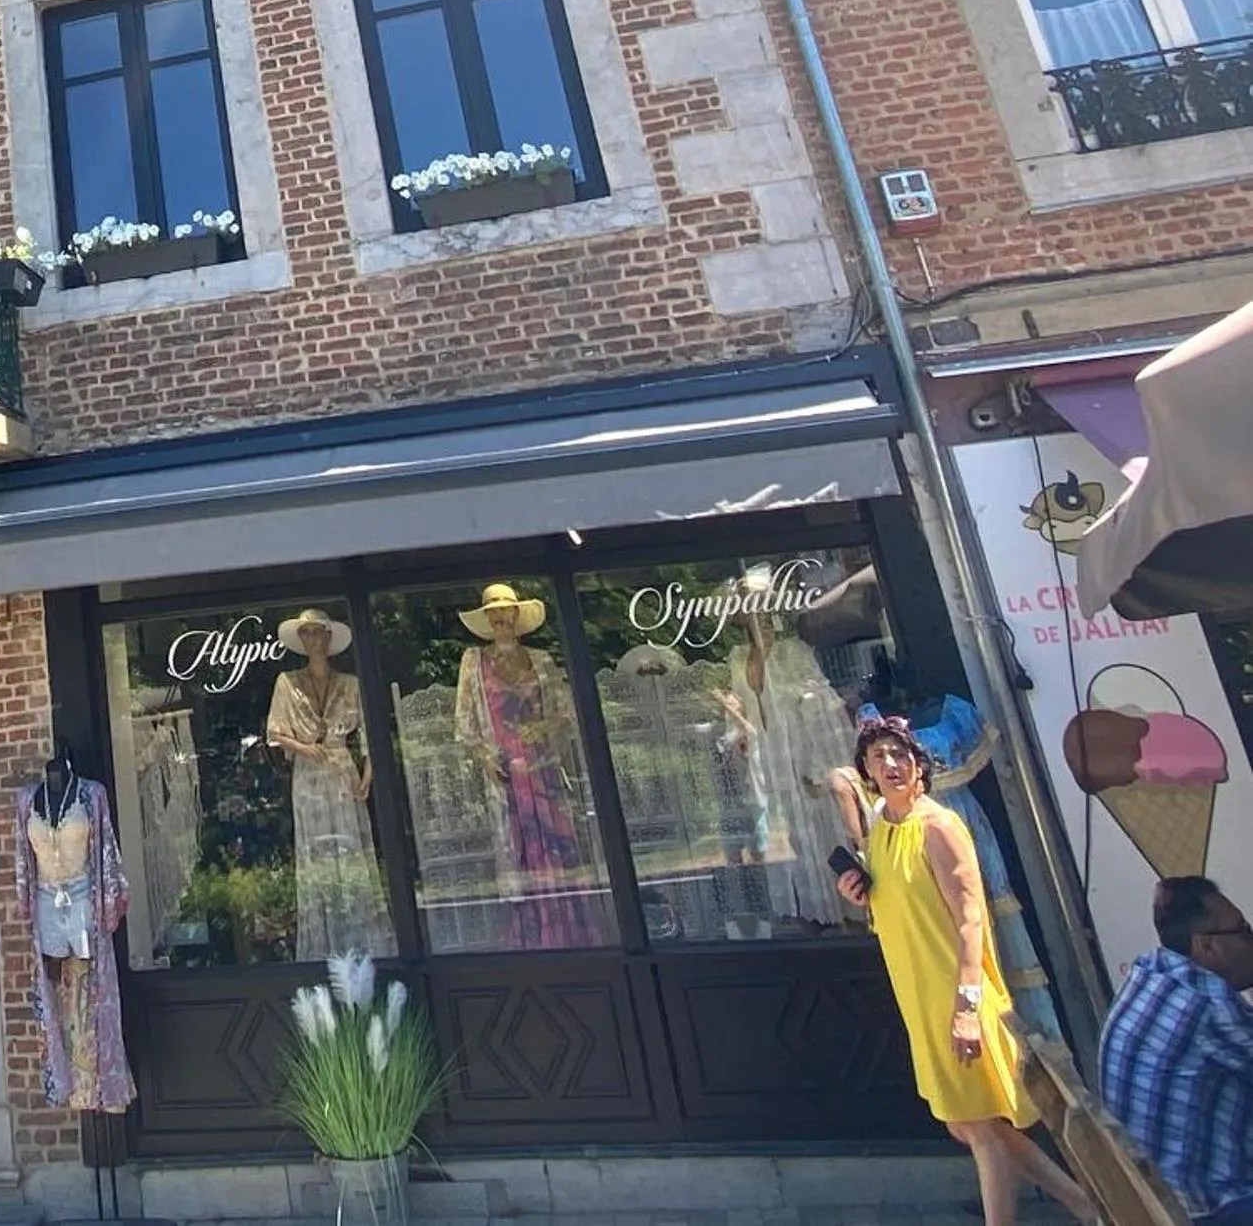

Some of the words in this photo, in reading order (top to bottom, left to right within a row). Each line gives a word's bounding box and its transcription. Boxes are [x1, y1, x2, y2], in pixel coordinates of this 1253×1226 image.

[629, 558, 822, 648] Sympathic
[1006, 596, 1032, 613] LA
[167, 615, 287, 693] Atypic
[1033, 626, 1060, 644] DE
